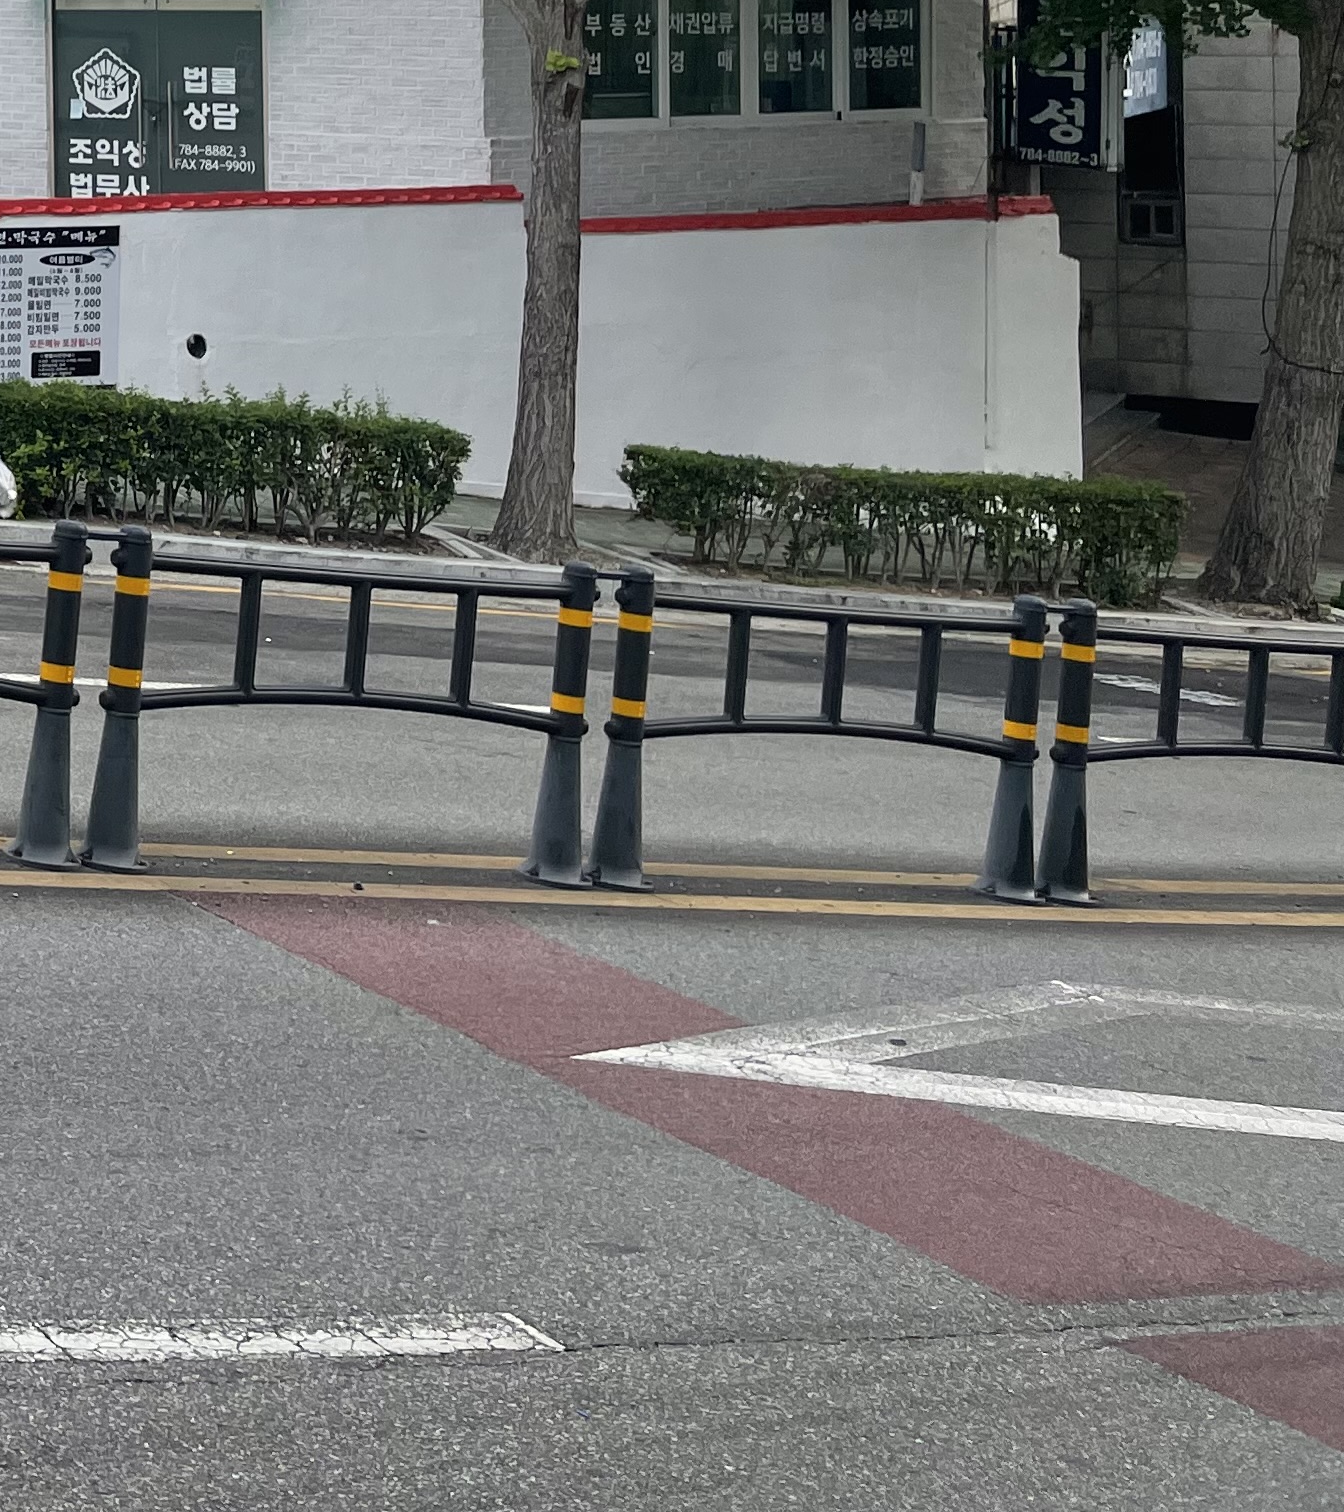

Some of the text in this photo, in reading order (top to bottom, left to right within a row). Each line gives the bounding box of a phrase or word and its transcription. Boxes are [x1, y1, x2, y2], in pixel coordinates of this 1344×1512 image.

[585, 13, 651, 37] 부동산
[762, 12, 824, 35] 지급명령
[852, 8, 913, 31] 상속포기
[763, 48, 825, 73] 답변서
[852, 45, 914, 69] 한정승인
[183, 66, 236, 94] 법률
[1029, 0, 1086, 144] 익성
[183, 101, 239, 130] 상담
[69, 139, 146, 168] 조익성
[173, 158, 196, 170] FAX
[69, 173, 150, 199] 법무사
[75, 273, 102, 283] 8.500
[74, 299, 101, 308] 7.000
[74, 311, 101, 320] 7.500
[27, 323, 100, 335] 감자만두 5.000
